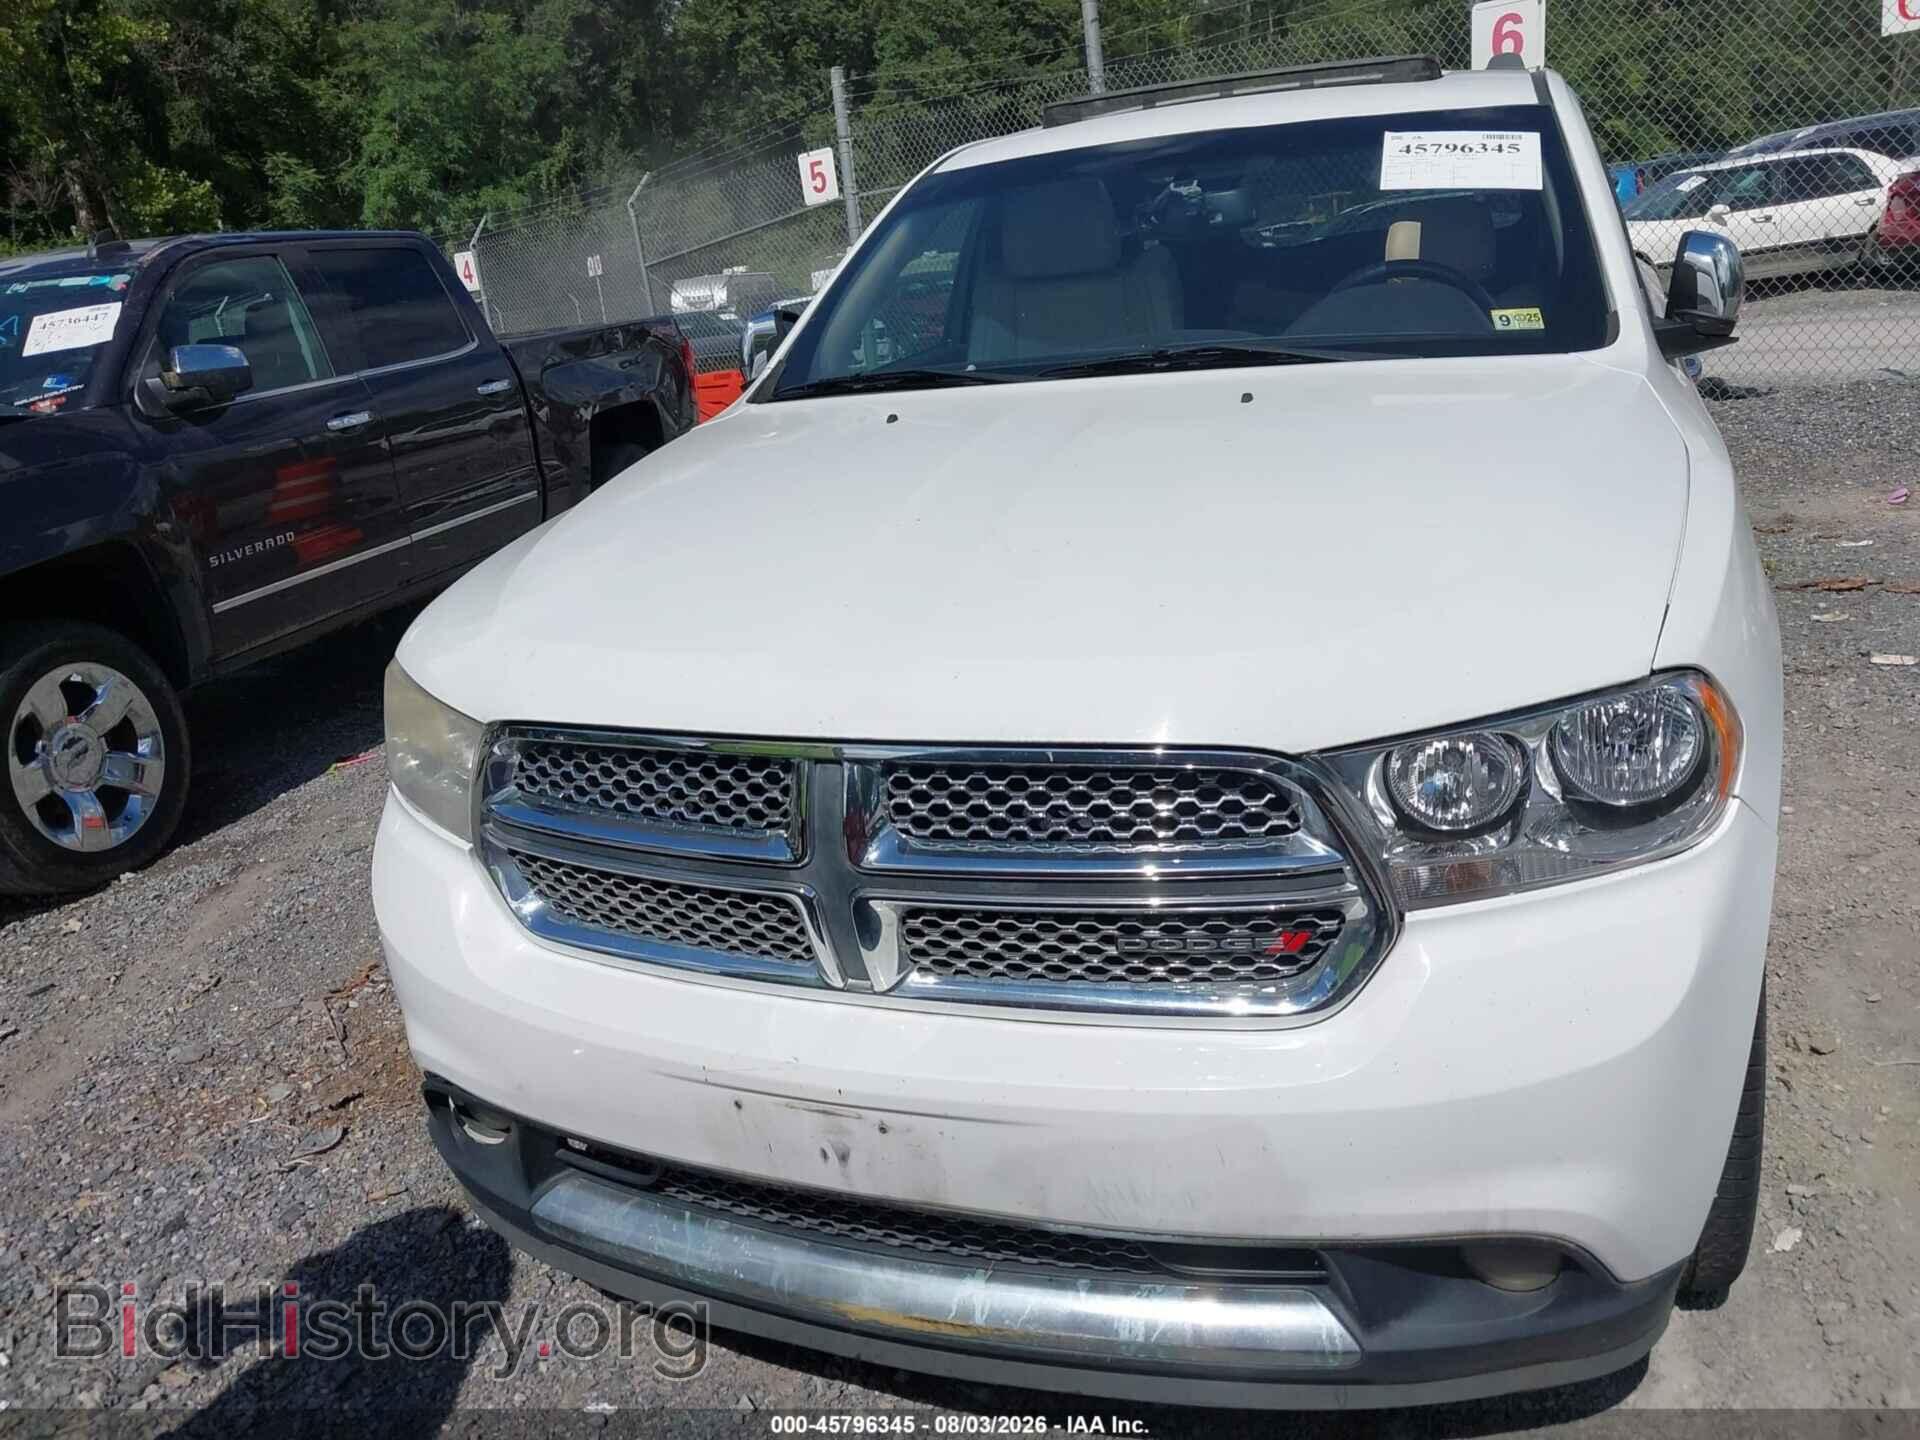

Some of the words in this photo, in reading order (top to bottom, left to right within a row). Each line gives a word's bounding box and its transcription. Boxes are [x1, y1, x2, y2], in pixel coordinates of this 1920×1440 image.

[1492, 12, 1524, 56] 6
[1398, 143, 1521, 155] 45796345
[810, 160, 827, 194] 5
[463, 259, 474, 284] 4
[1498, 314, 1511, 327] 9
[1526, 312, 1541, 322] 25
[208, 531, 295, 568] SILVERADO
[1117, 937, 1285, 951] DODGE
